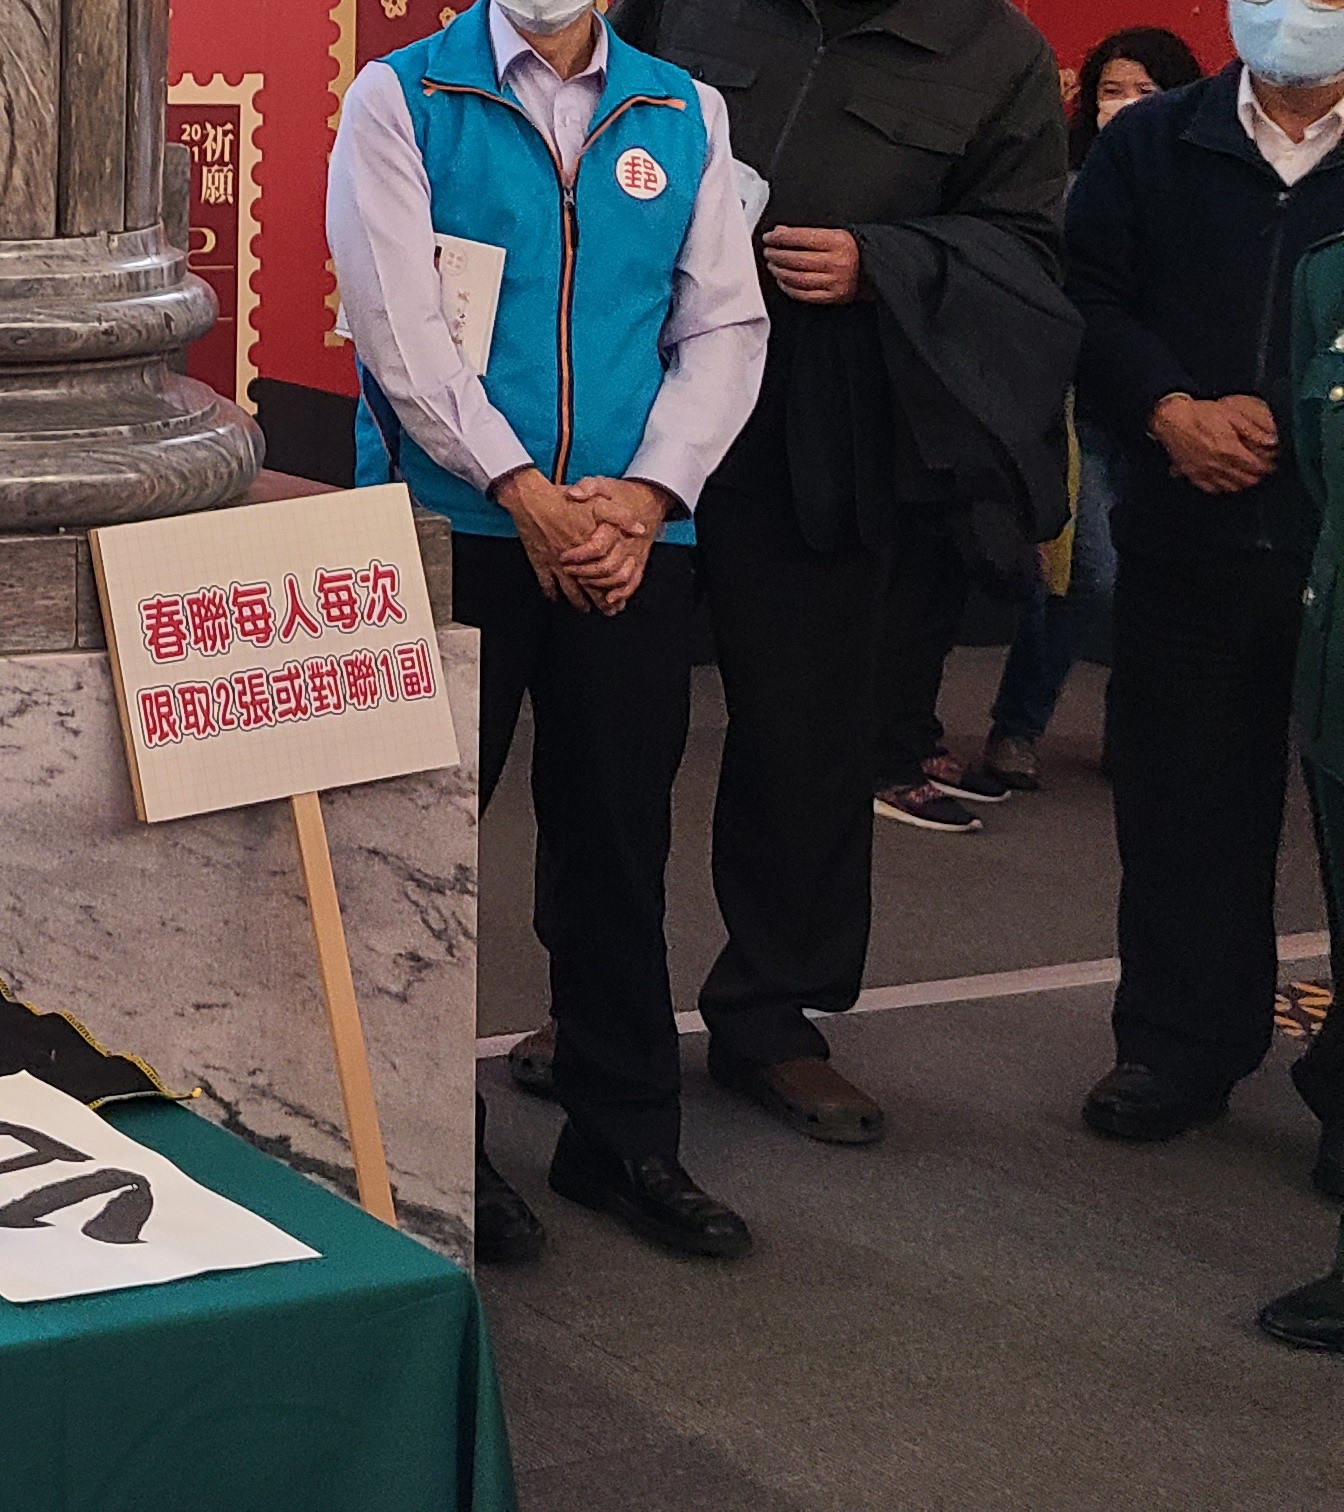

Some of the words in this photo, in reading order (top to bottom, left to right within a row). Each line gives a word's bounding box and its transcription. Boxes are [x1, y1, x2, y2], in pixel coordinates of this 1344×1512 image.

[180, 123, 202, 141] 20
[201, 120, 234, 205] 祈願
[141, 561, 406, 663] 春聯每人每次
[139, 642, 434, 745] 限取2張或對聯1副
